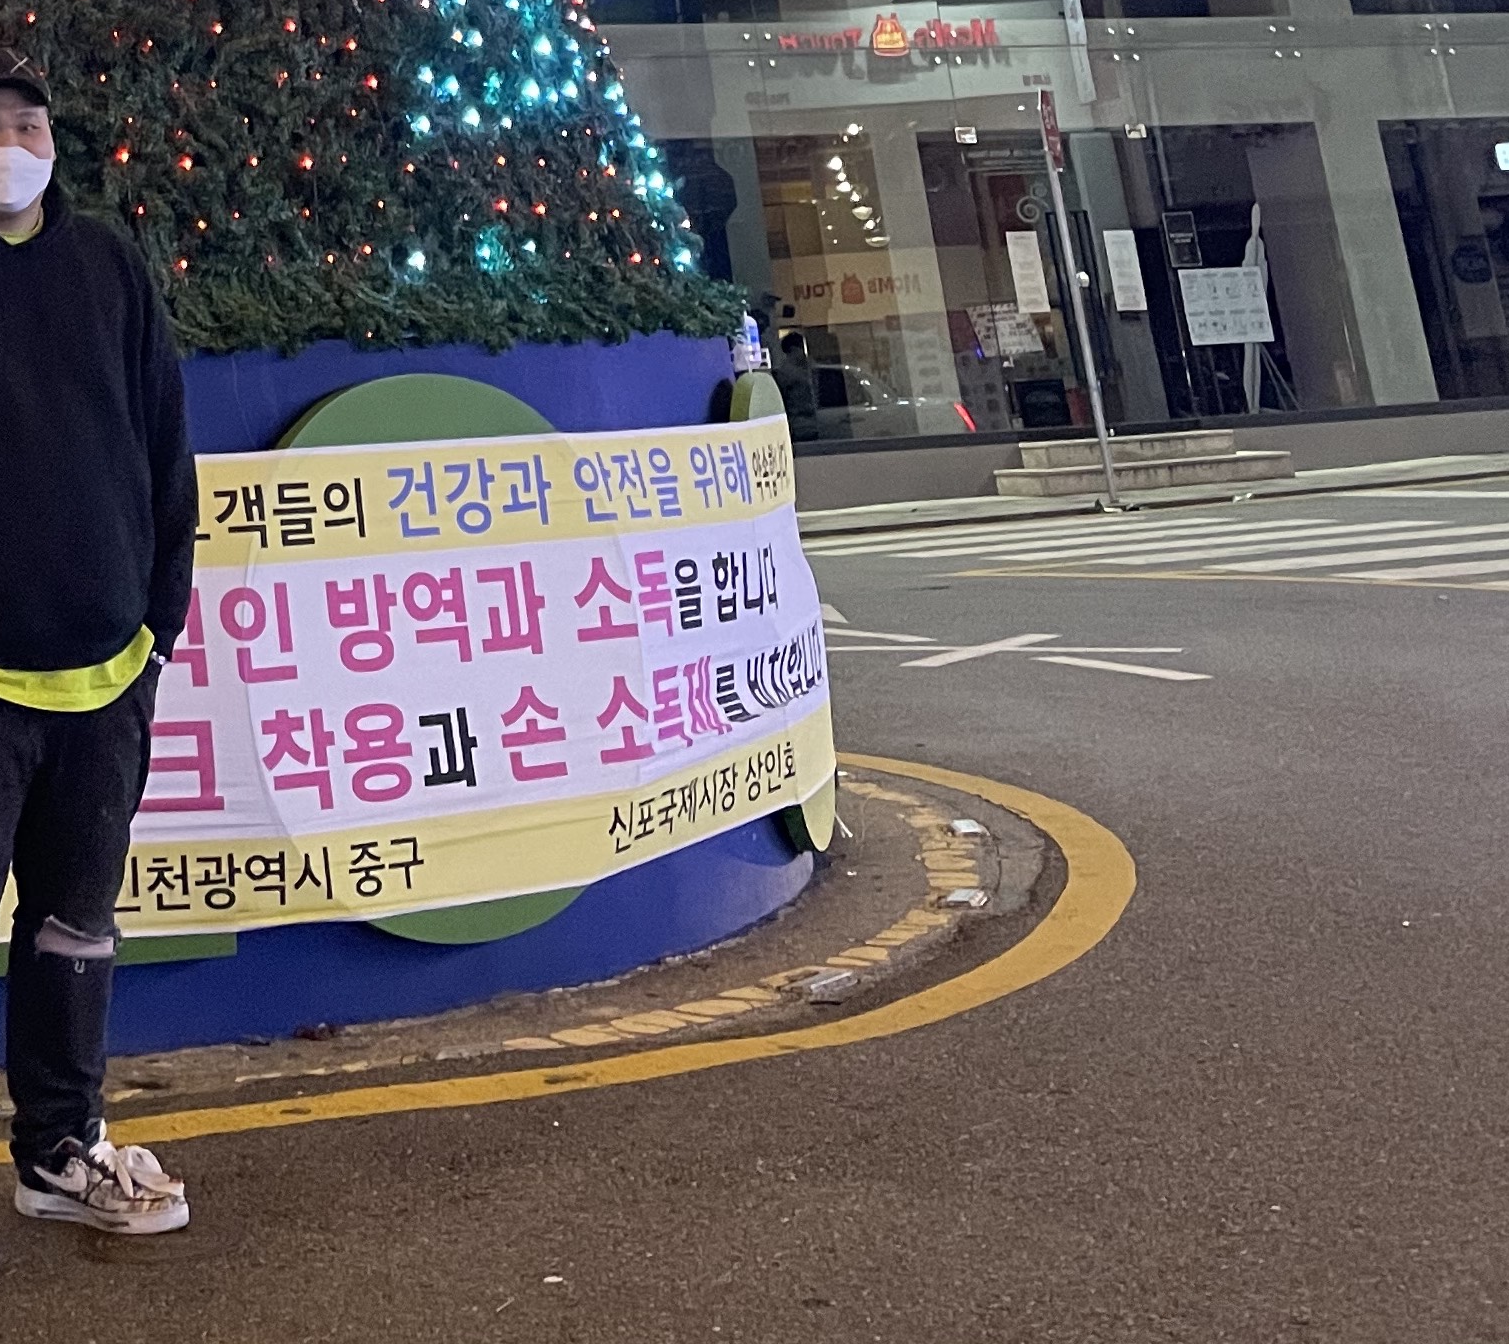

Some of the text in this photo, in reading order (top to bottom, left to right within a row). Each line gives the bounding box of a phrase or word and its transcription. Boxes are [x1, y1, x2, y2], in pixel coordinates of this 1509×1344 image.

[196, 477, 366, 548] 객들의
[387, 454, 552, 540] 건강과
[574, 445, 683, 522] 안전을
[690, 440, 753, 509] 위해
[325, 560, 546, 673] 방역과
[573, 550, 703, 643] 소독을
[712, 543, 779, 624] 합니다
[261, 703, 479, 811] 착용과
[501, 685, 569, 782] 손
[597, 655, 763, 767] 소독제를
[607, 766, 739, 855] 신포국제시장
[348, 836, 426, 898] 중구
